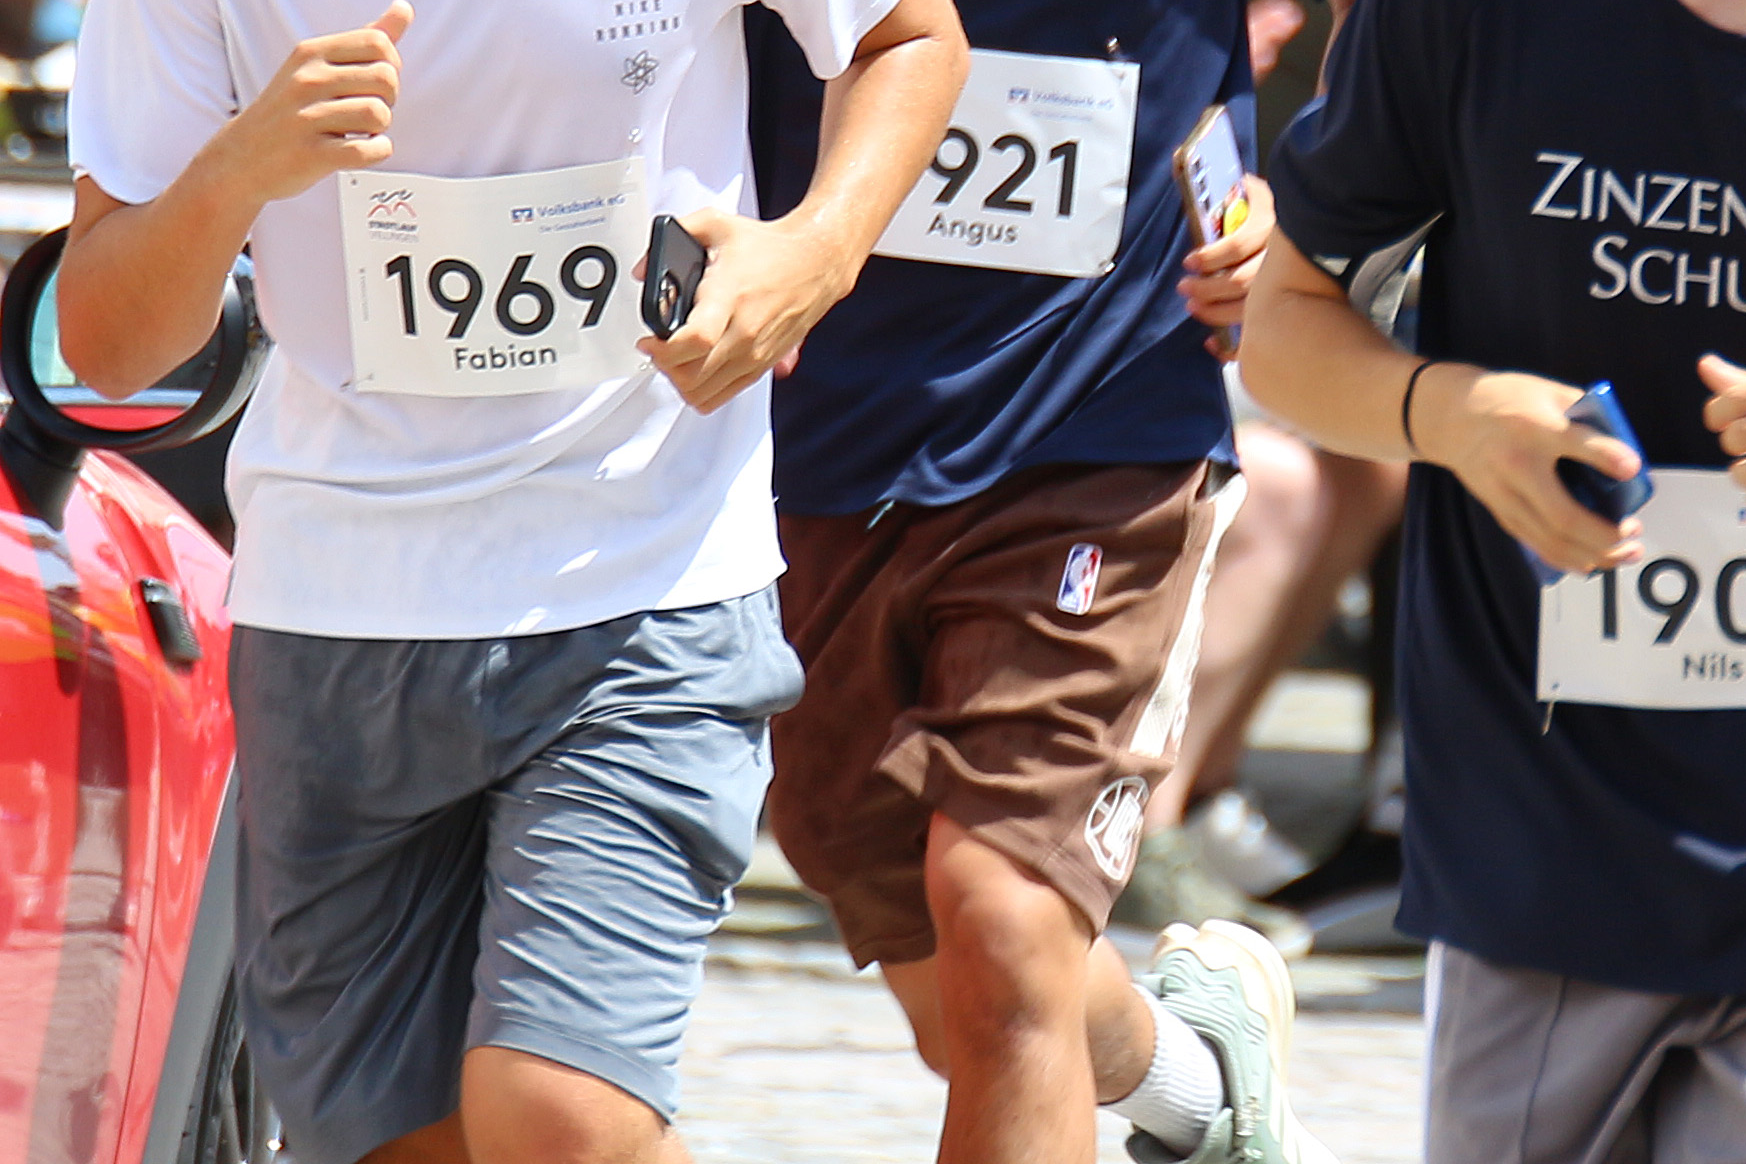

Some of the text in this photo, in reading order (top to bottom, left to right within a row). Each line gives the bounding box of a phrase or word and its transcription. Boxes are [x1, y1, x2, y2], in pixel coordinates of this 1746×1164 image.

[926, 213, 1018, 246] Angus
[385, 244, 617, 339] 1969
[454, 344, 557, 371] Fabian
[1682, 653, 1744, 680] Nils
